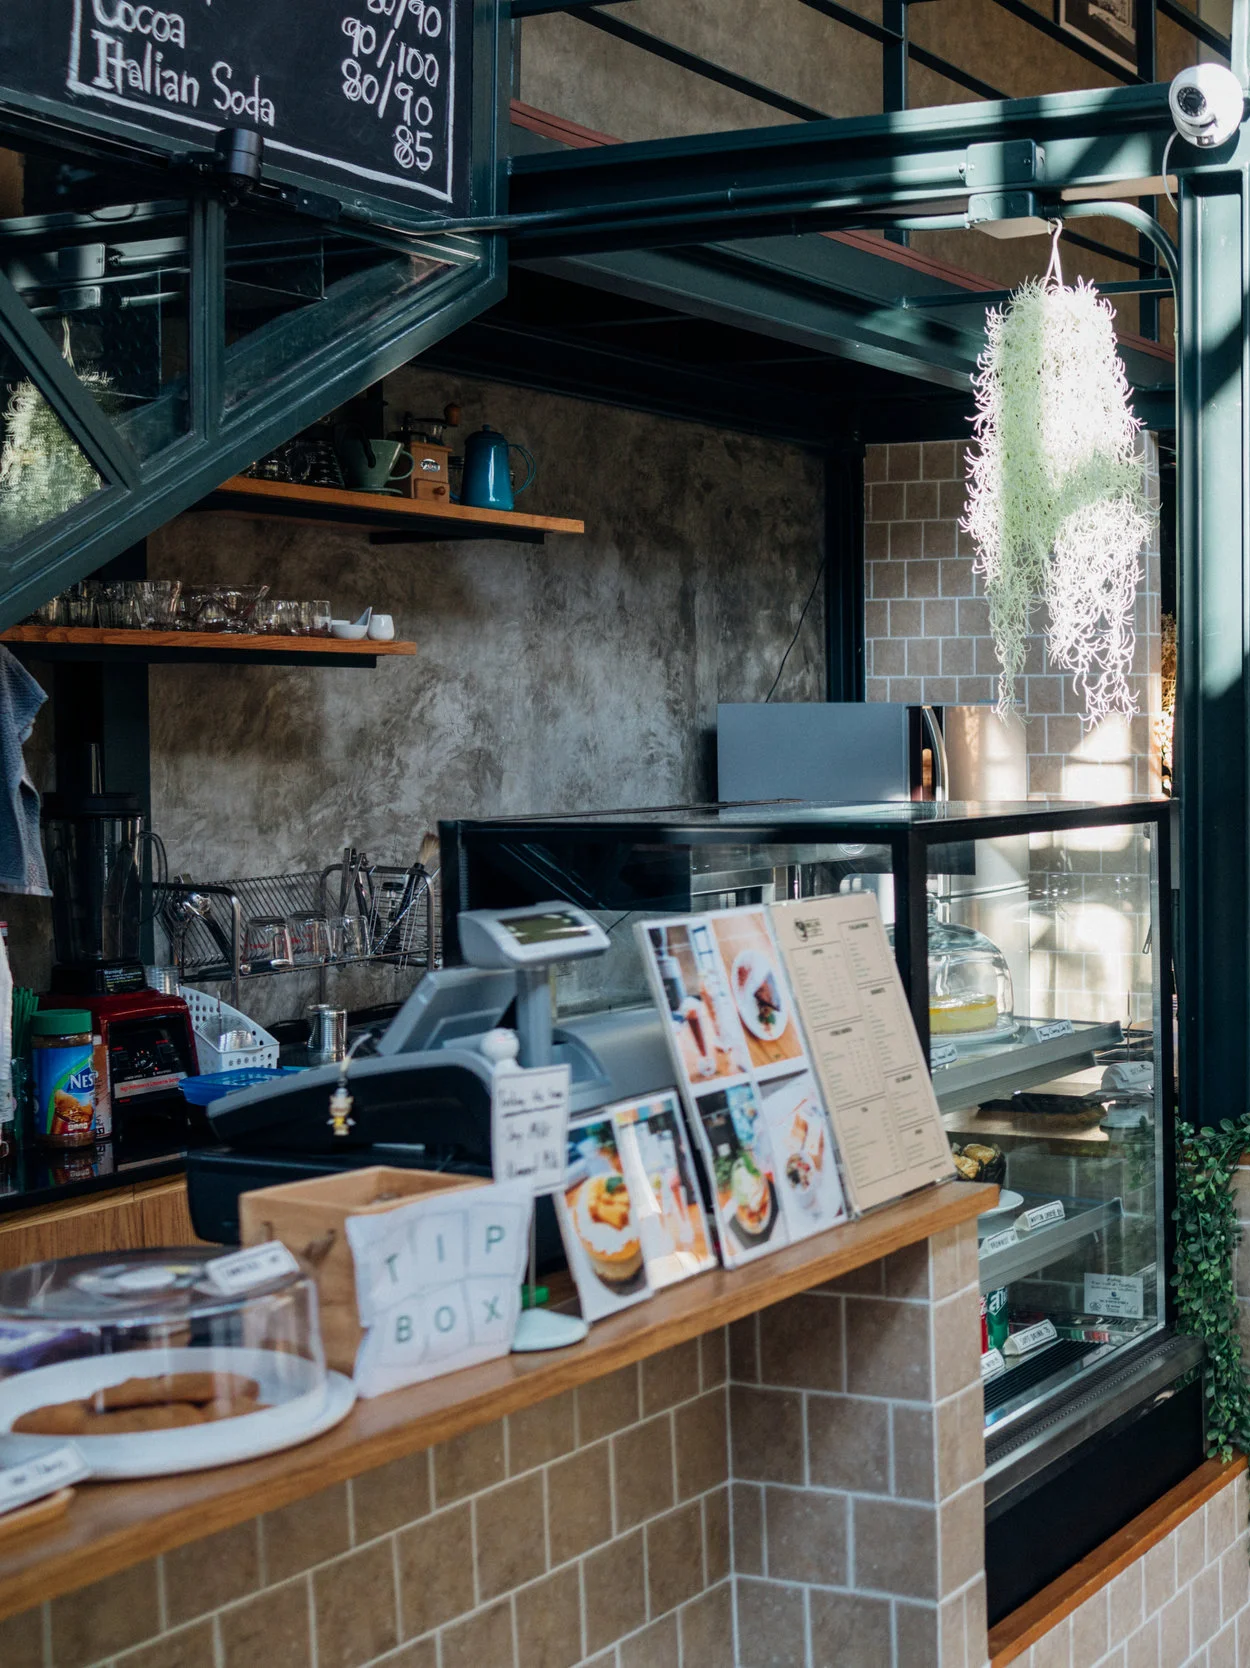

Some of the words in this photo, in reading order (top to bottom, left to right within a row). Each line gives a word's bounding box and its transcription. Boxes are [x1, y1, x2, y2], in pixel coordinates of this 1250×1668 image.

[92, 0, 186, 49] Cocoa
[341, 58, 434, 126] 80/90
[341, 17, 440, 88] 90/100
[90, 29, 200, 108] Italian
[211, 61, 275, 127] Soda
[393, 125, 434, 171] 85
[384, 1224, 506, 1283] TIP
[395, 1296, 503, 1344] BOX
